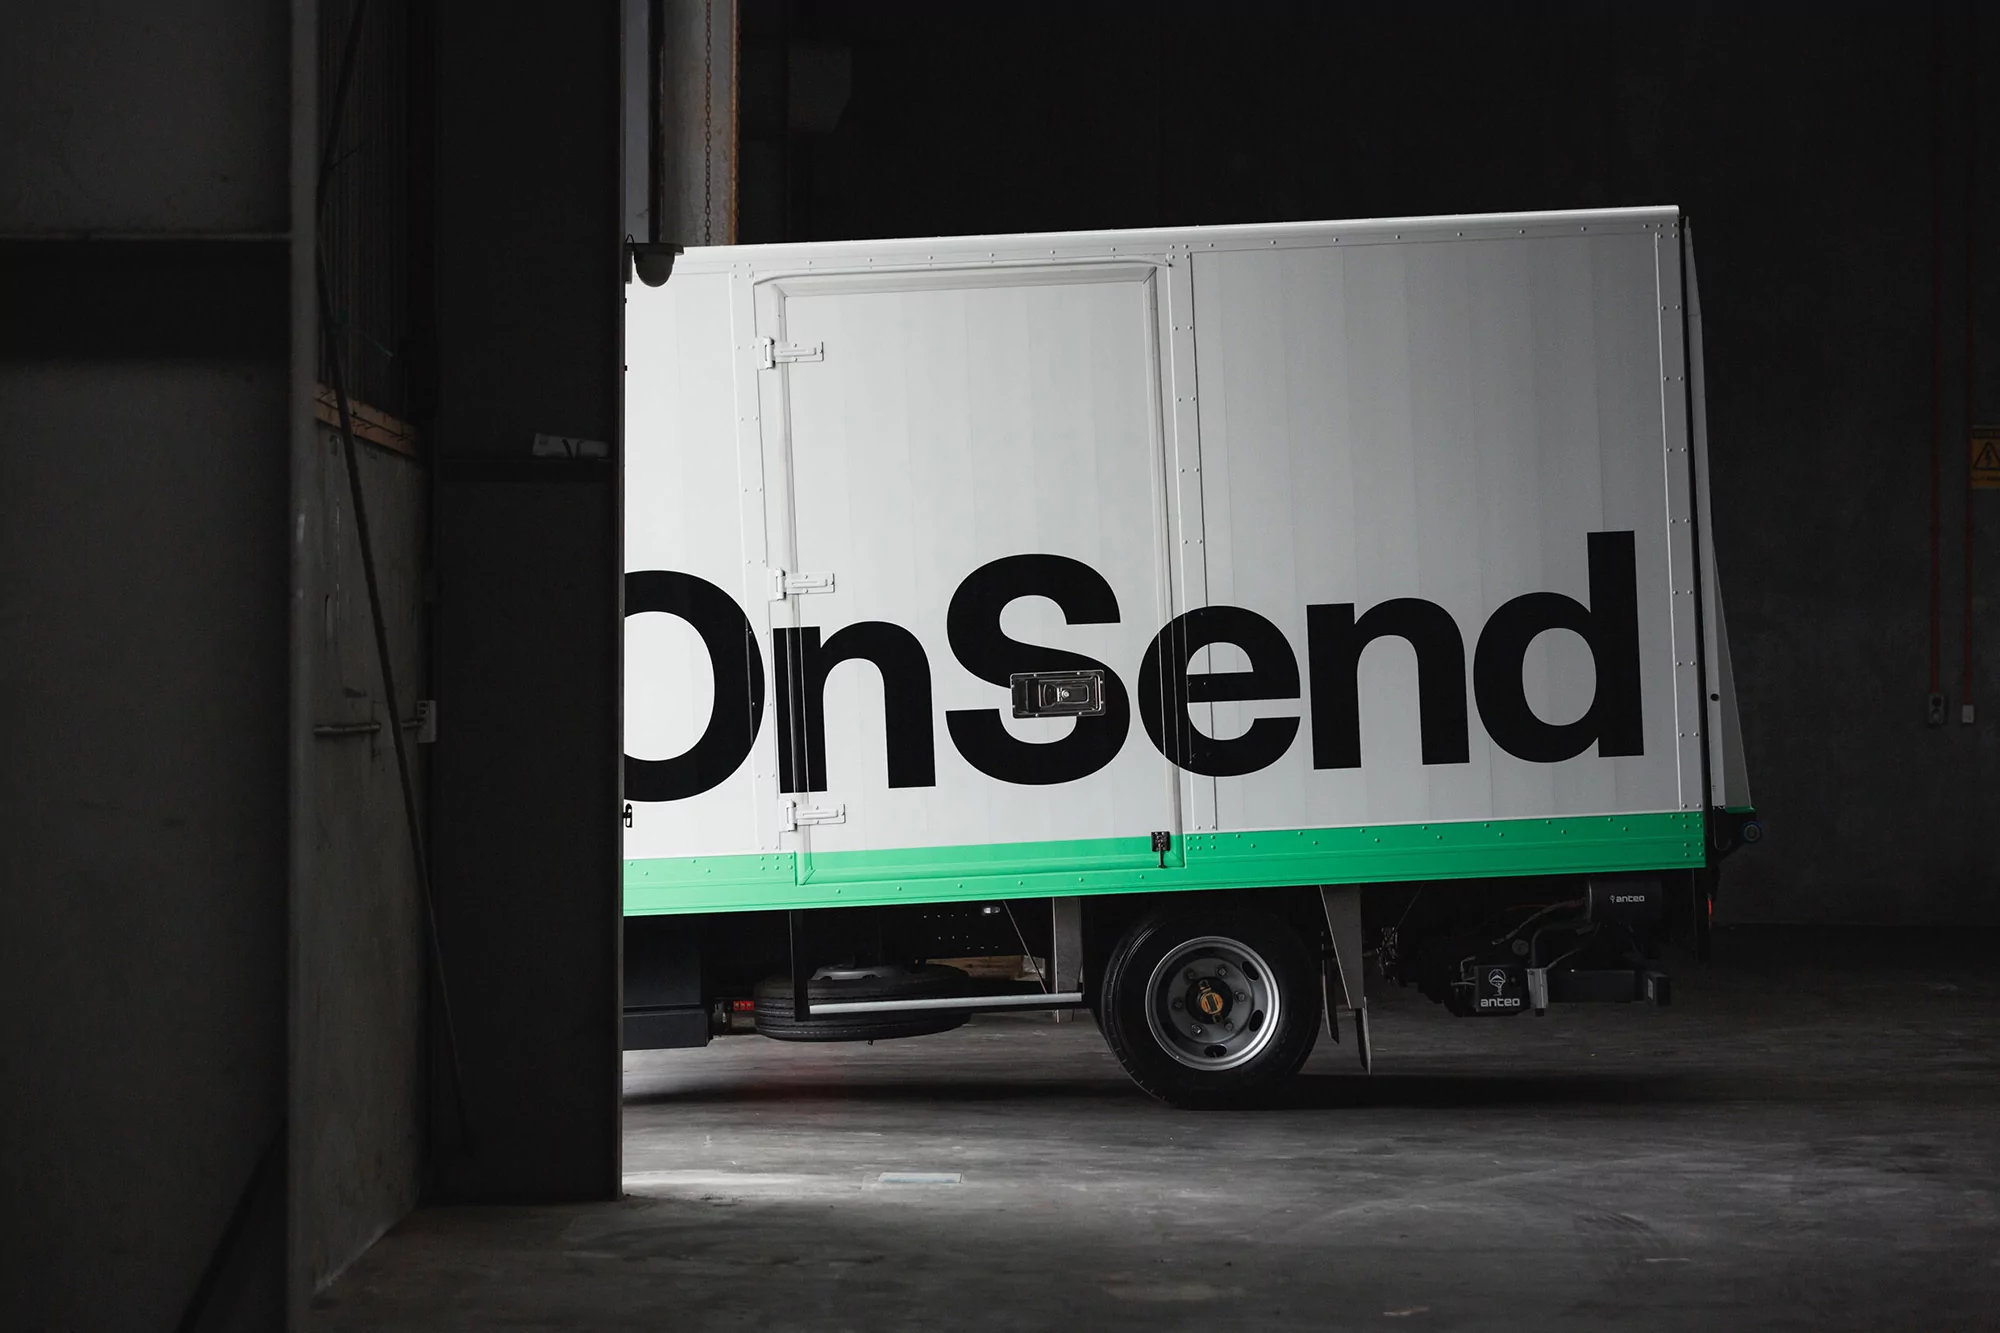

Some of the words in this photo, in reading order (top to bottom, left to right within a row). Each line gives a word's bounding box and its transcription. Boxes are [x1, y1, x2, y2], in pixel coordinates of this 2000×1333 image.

[624, 531, 1644, 802] OnSend
[1615, 895, 1646, 903] anteo
[1480, 997, 1521, 1007] anteo
